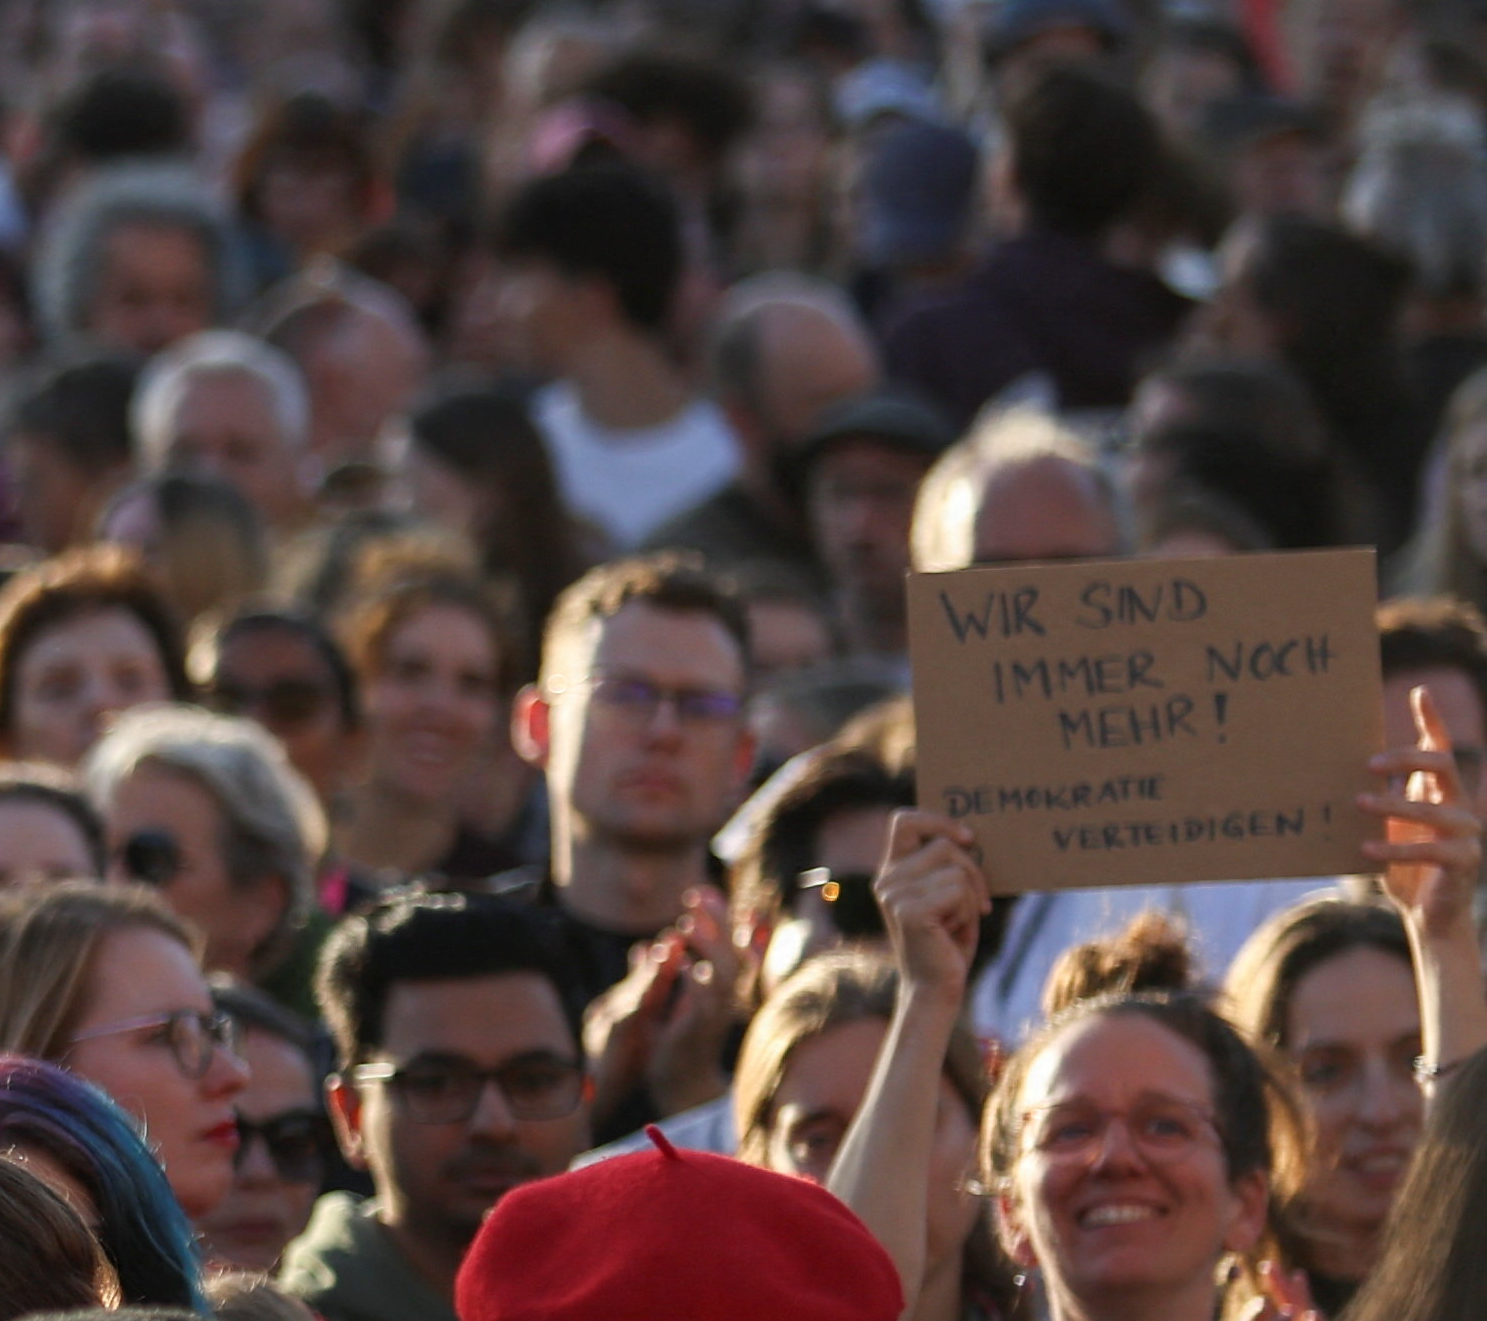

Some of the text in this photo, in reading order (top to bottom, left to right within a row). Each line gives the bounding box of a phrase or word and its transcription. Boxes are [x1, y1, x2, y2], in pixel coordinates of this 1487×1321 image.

[939, 578, 1208, 645] WIR SIND
[992, 635, 1338, 704] IMMER NOCH
[941, 773, 1165, 820] DEMOKRATIE
